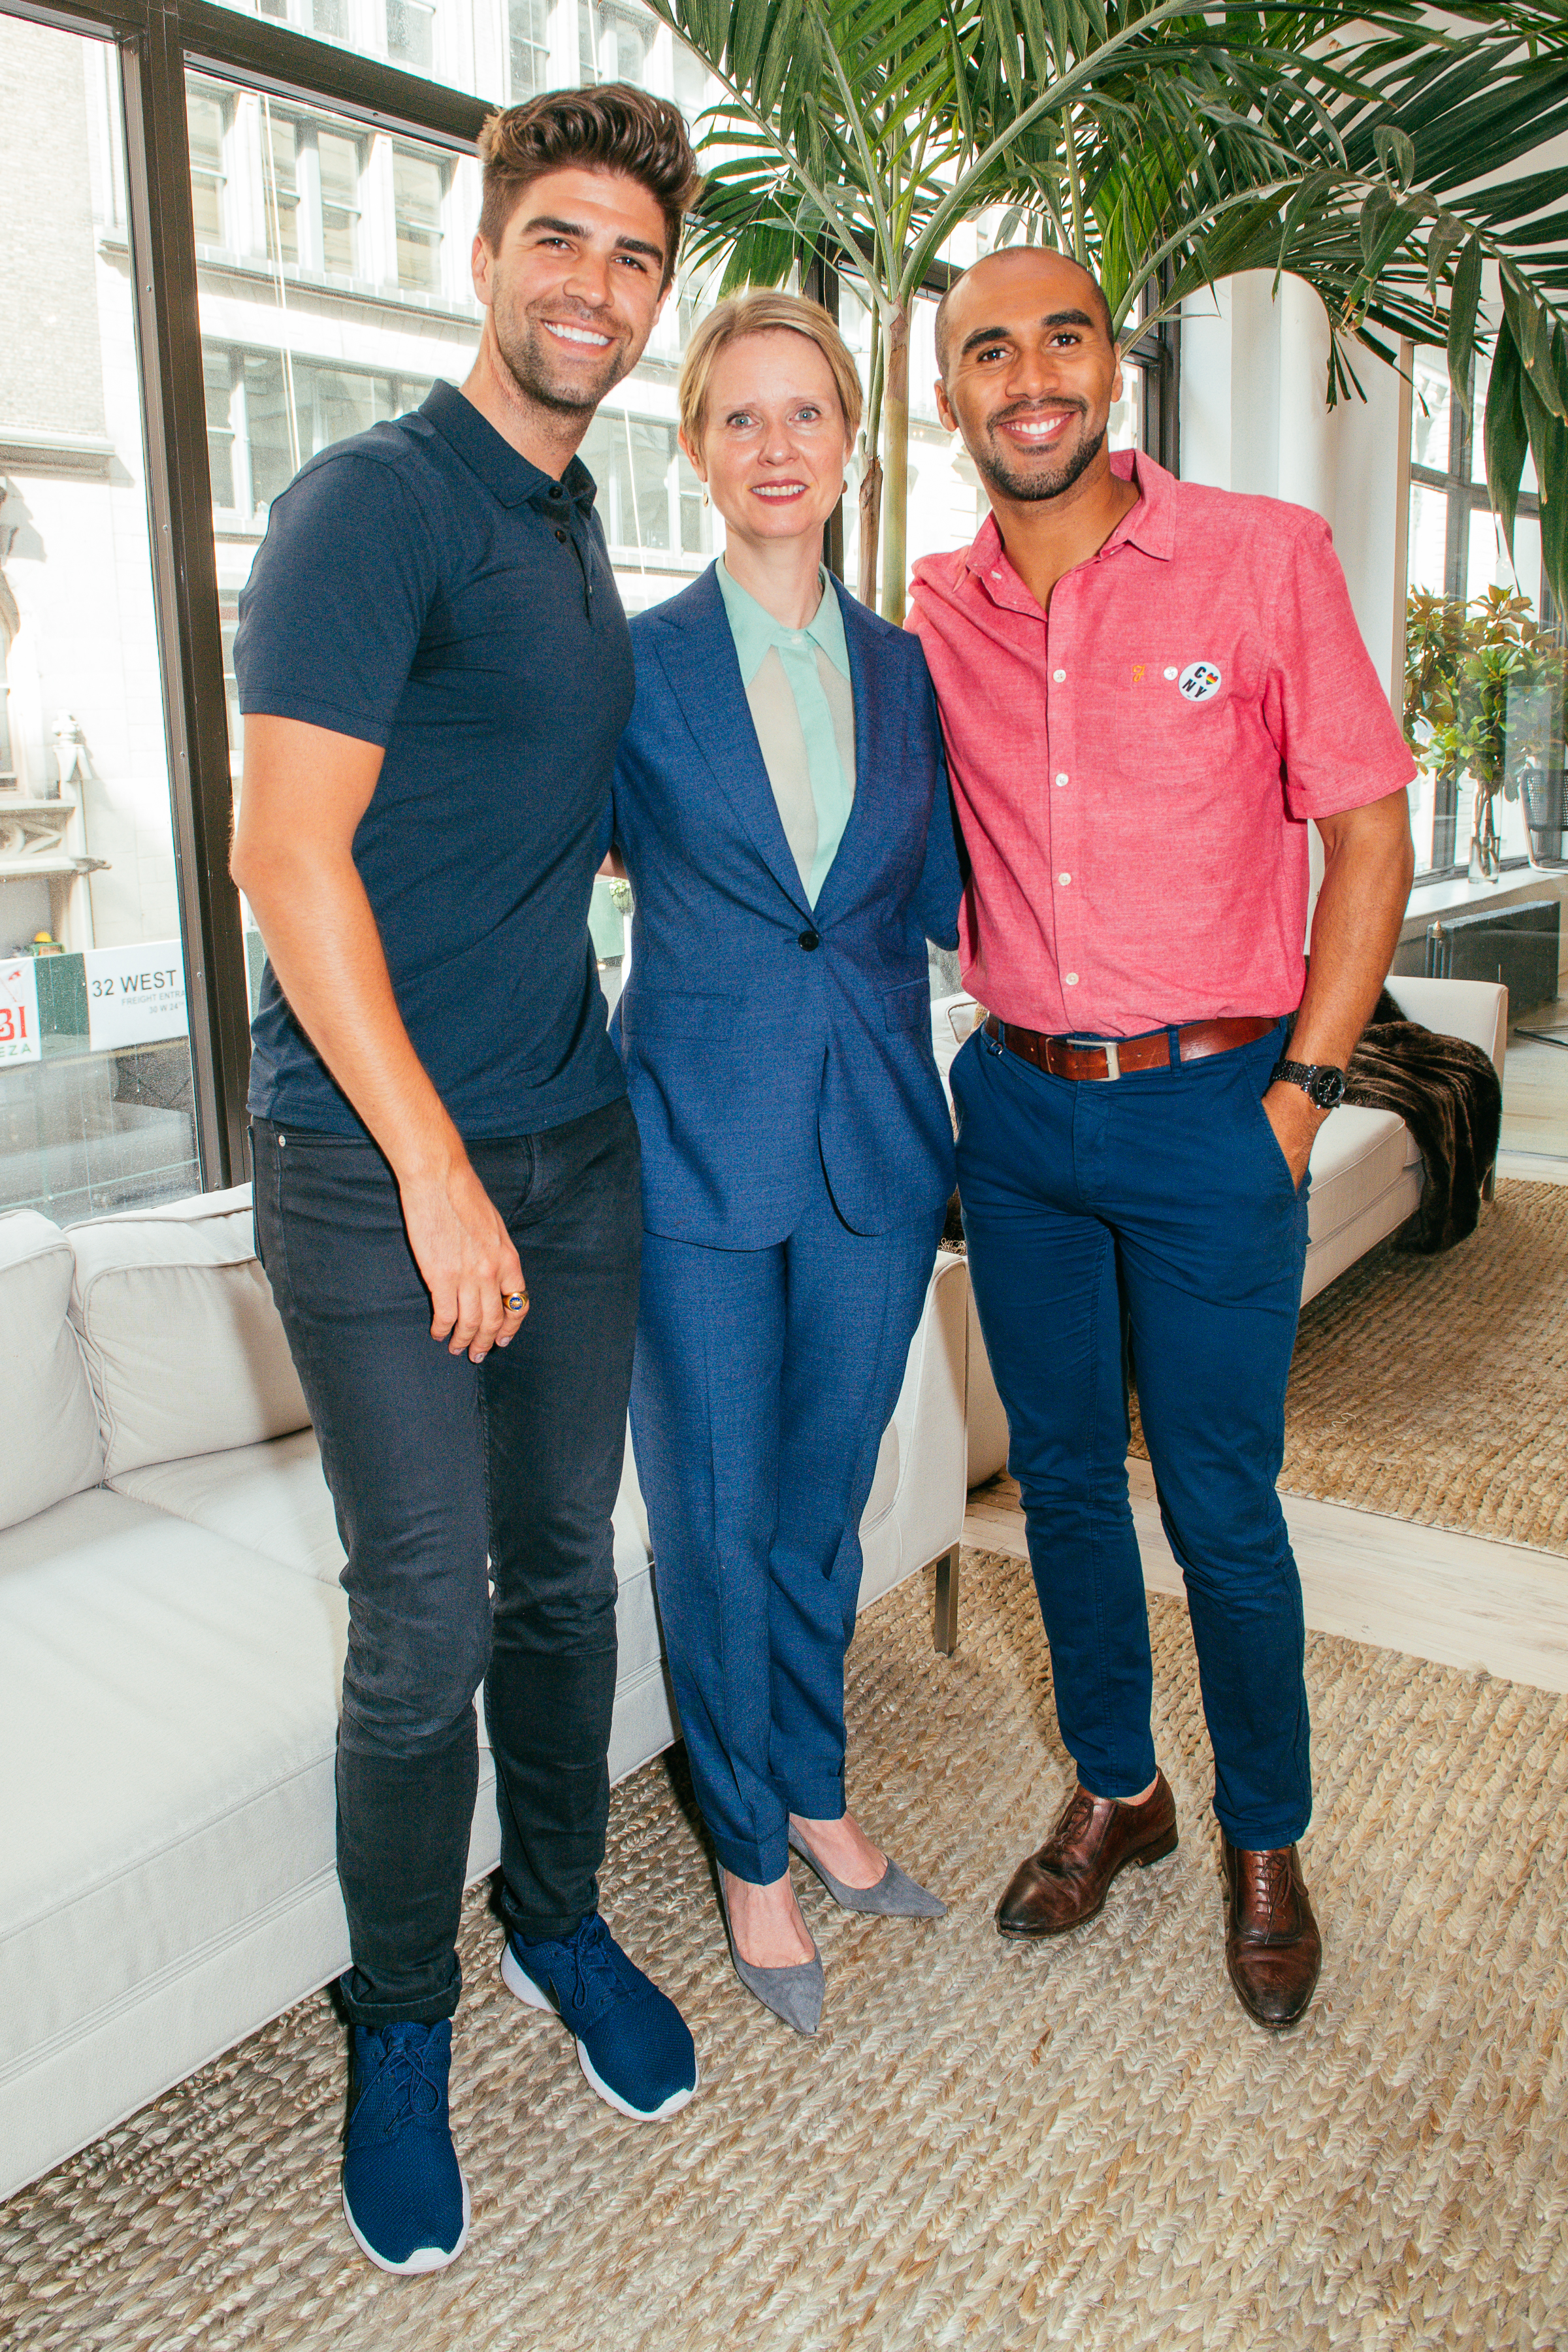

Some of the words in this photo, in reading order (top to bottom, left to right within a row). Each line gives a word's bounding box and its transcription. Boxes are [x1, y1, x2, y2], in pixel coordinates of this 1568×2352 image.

[1182, 678, 1207, 698] NY
[92, 979, 114, 997] 32
[120, 970, 177, 993] WEST
[121, 994, 157, 1005] FREIGHT
